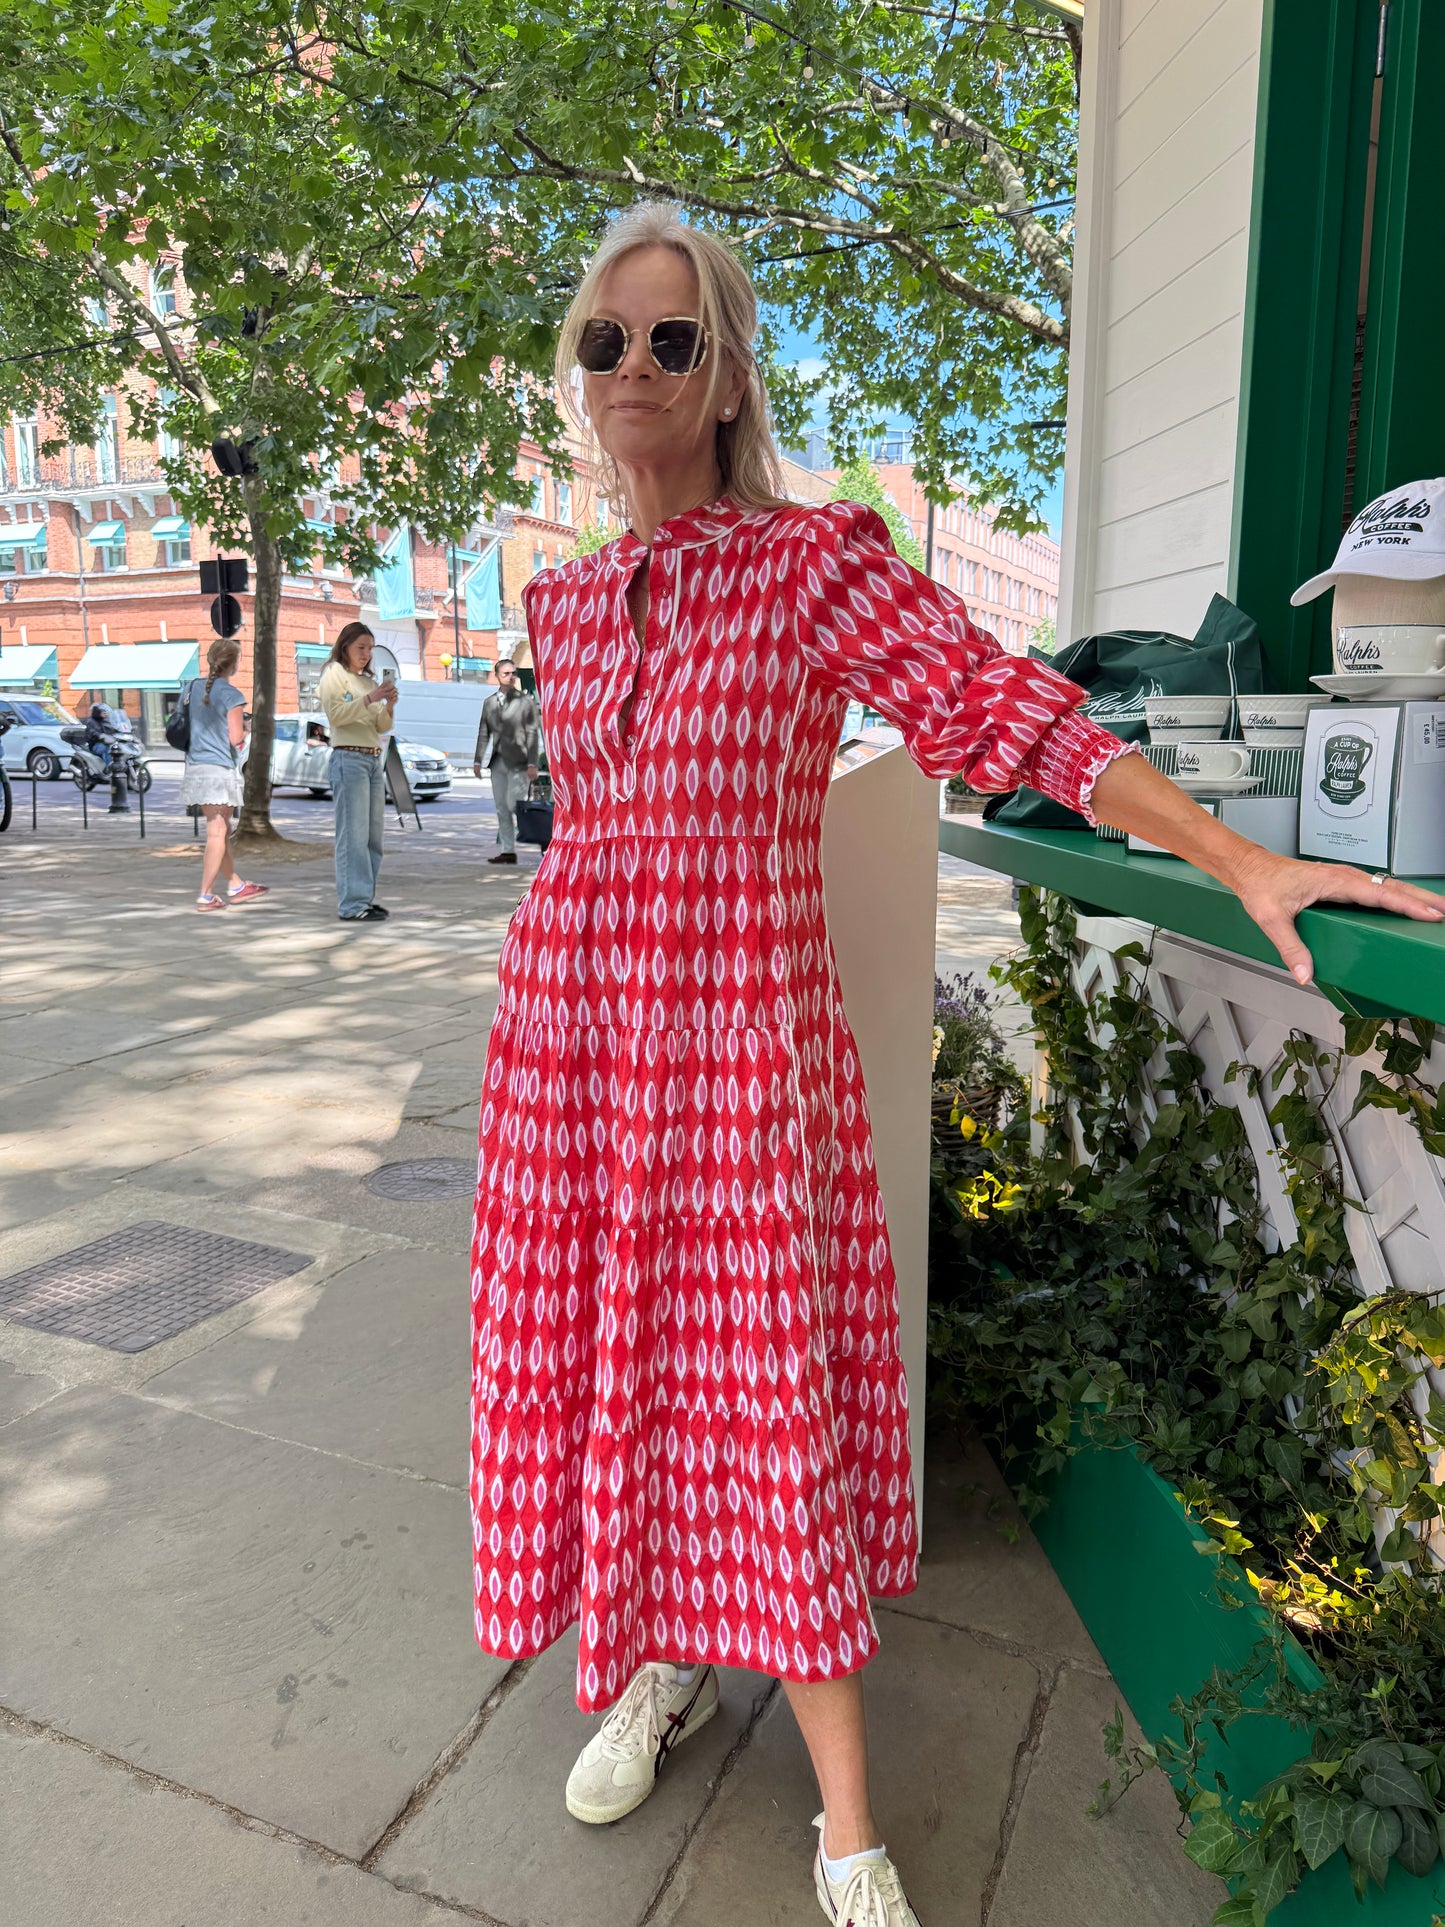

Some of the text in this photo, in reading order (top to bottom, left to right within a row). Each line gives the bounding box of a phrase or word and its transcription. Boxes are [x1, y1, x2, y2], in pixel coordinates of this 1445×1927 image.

[1348, 497, 1431, 534] Ralph's
[1370, 523, 1412, 532] COFFEE
[1351, 537, 1411, 552] NEW YORK
[1351, 742, 1360, 750] OF
